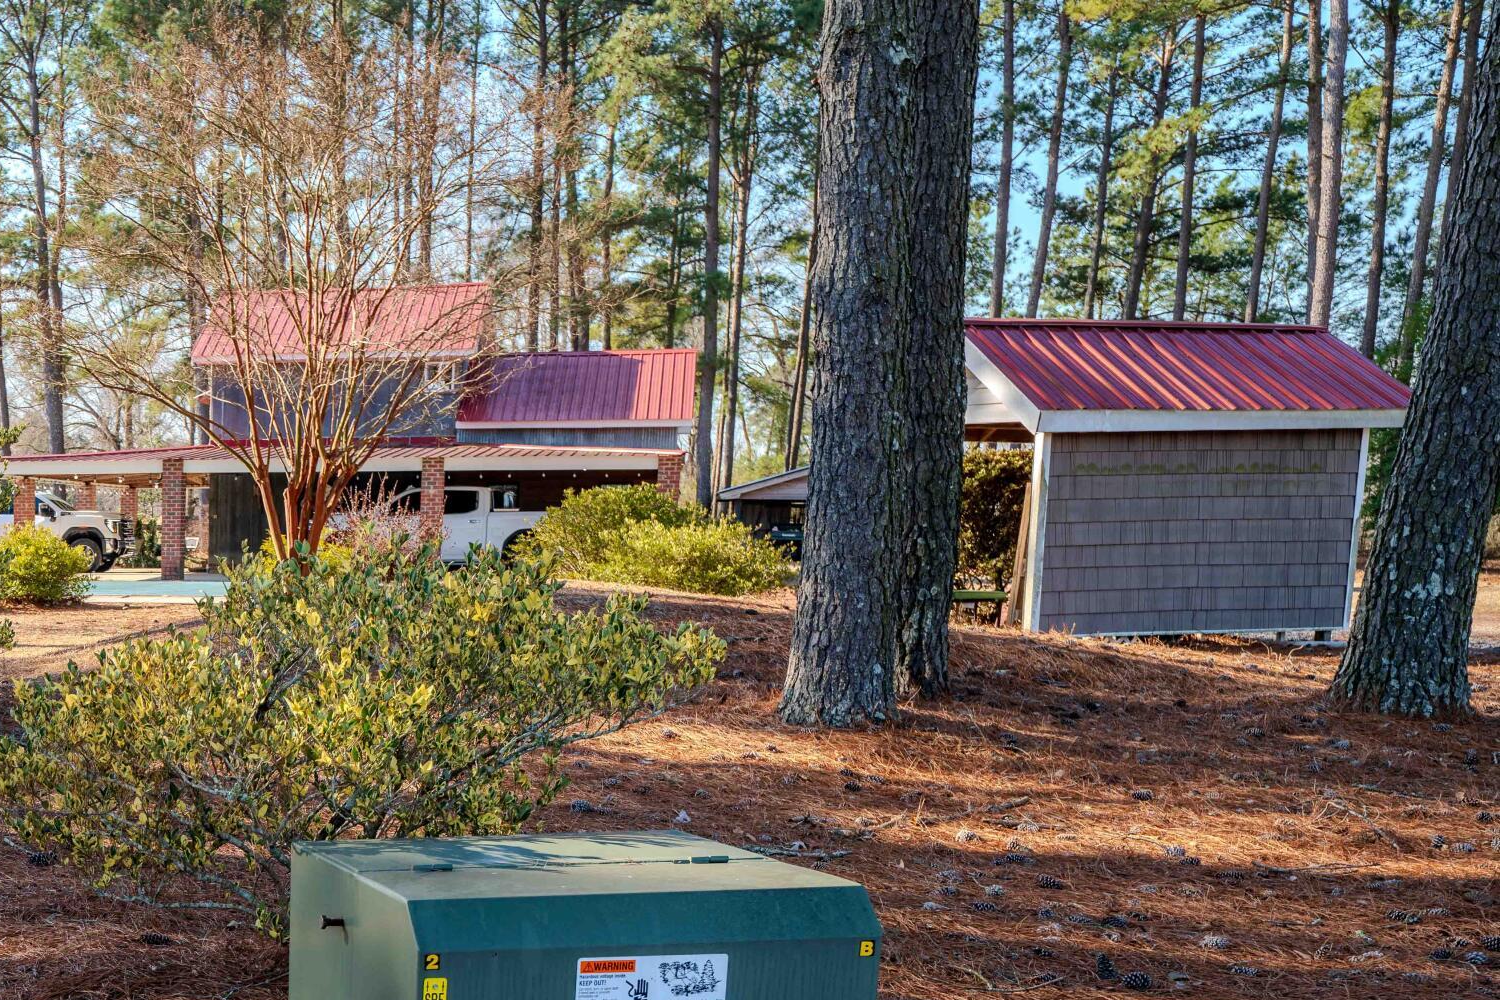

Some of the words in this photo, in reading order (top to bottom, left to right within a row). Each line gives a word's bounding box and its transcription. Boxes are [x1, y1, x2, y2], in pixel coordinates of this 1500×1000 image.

[859, 941, 874, 957] B
[426, 954, 439, 970] 2
[593, 961, 633, 971] WARNING
